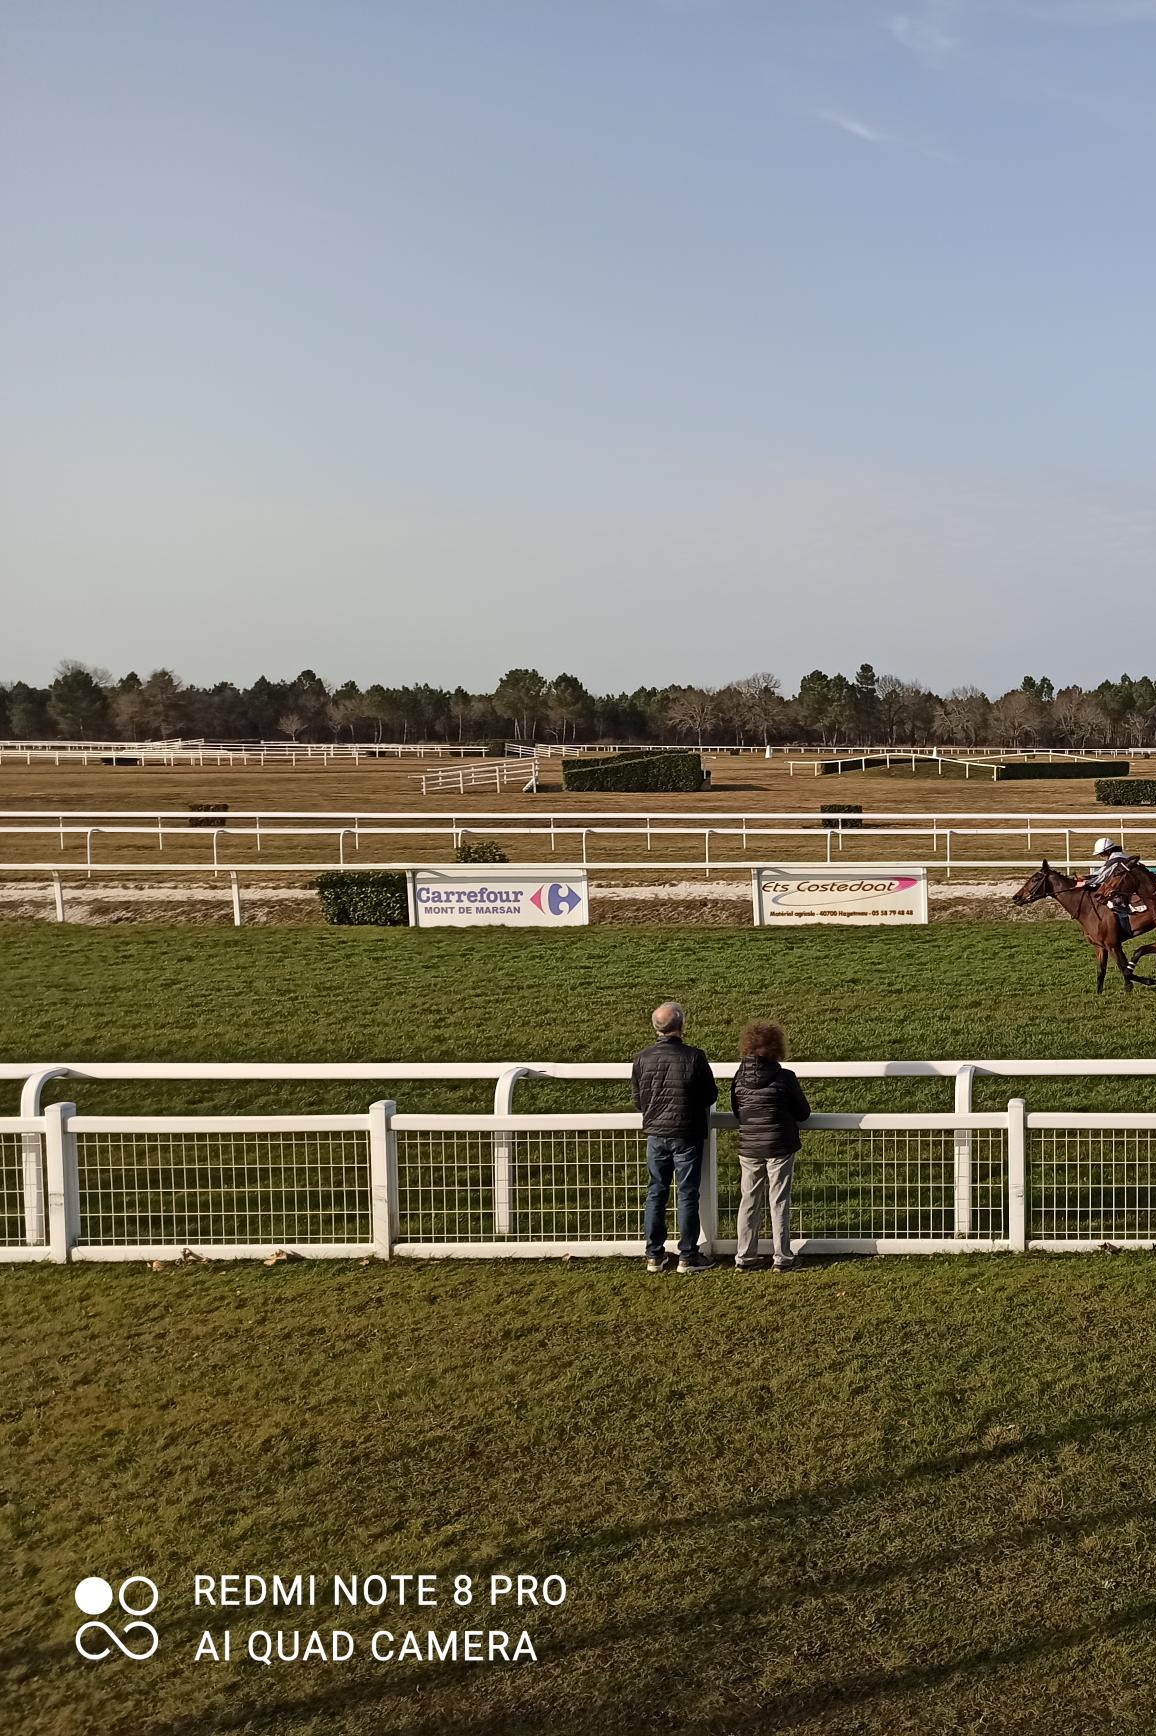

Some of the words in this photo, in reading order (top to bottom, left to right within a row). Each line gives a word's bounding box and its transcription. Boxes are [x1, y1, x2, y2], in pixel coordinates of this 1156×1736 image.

[761, 881, 789, 893] Ets
[796, 881, 896, 893] Costedoat
[416, 887, 523, 904] Carrefour
[424, 906, 455, 915] MONT
[458, 906, 472, 915] DE
[475, 906, 521, 915] MARSAN
